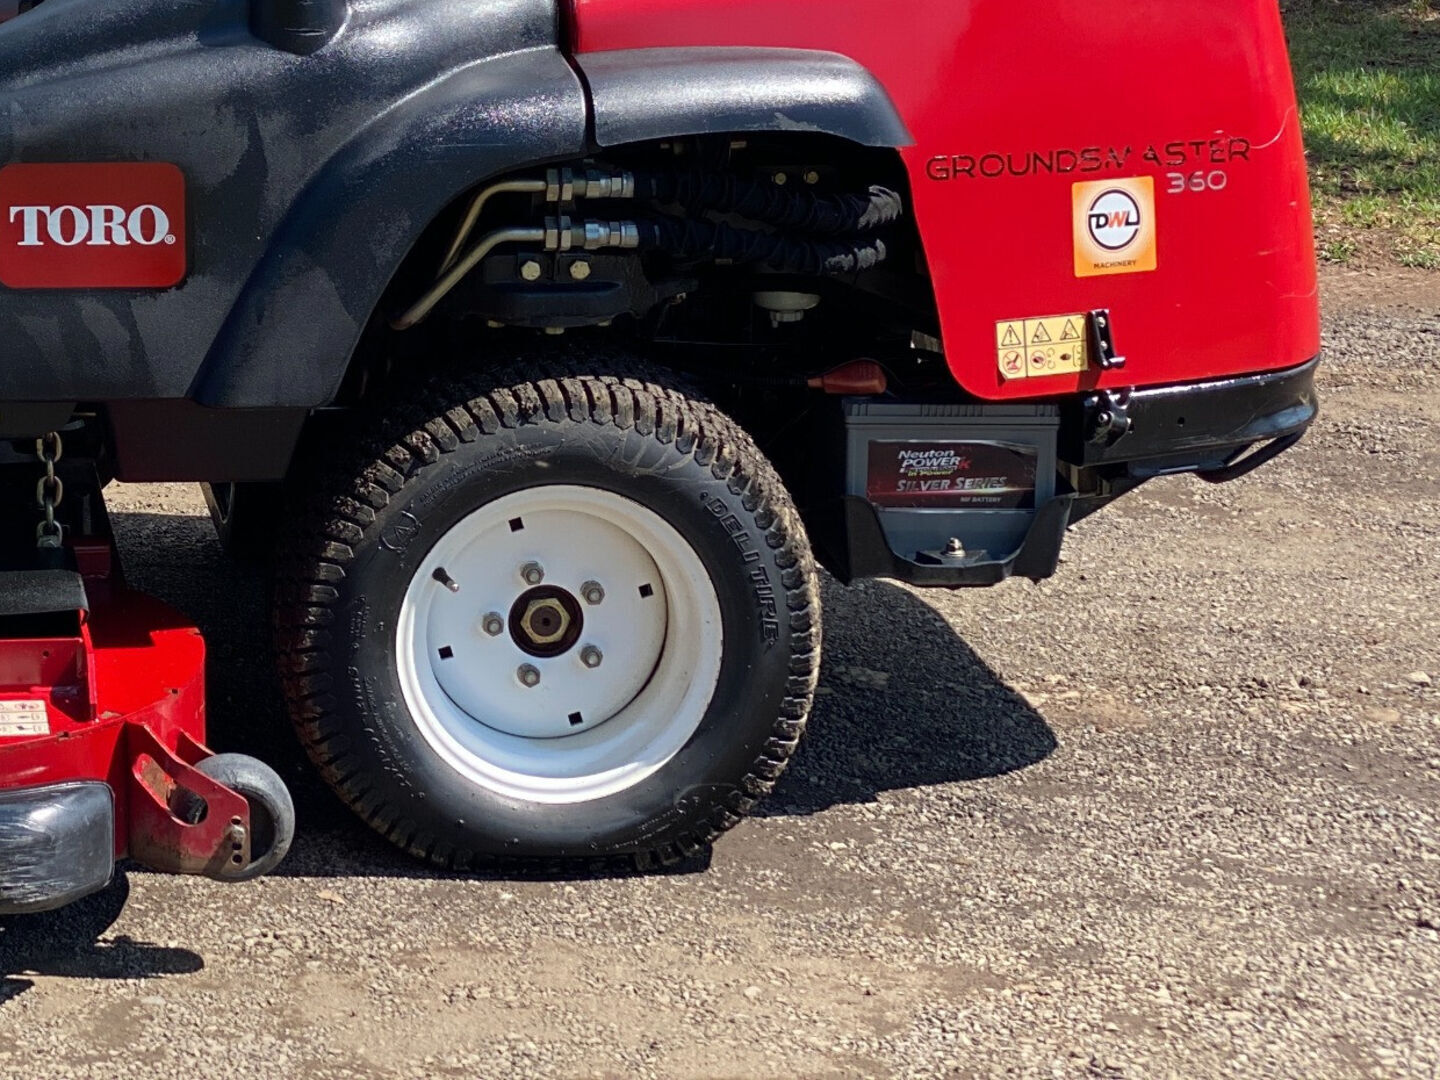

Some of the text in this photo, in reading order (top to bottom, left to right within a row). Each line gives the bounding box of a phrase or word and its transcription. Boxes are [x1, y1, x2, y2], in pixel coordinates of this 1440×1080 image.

[1167, 170, 1227, 193] 360
[1090, 211, 1140, 229] DWL
[1093, 260, 1137, 269] MACHINERY
[898, 450, 955, 460] Neuton
[902, 457, 961, 468] POWER
[896, 476, 1008, 492] SILVER SERIES
